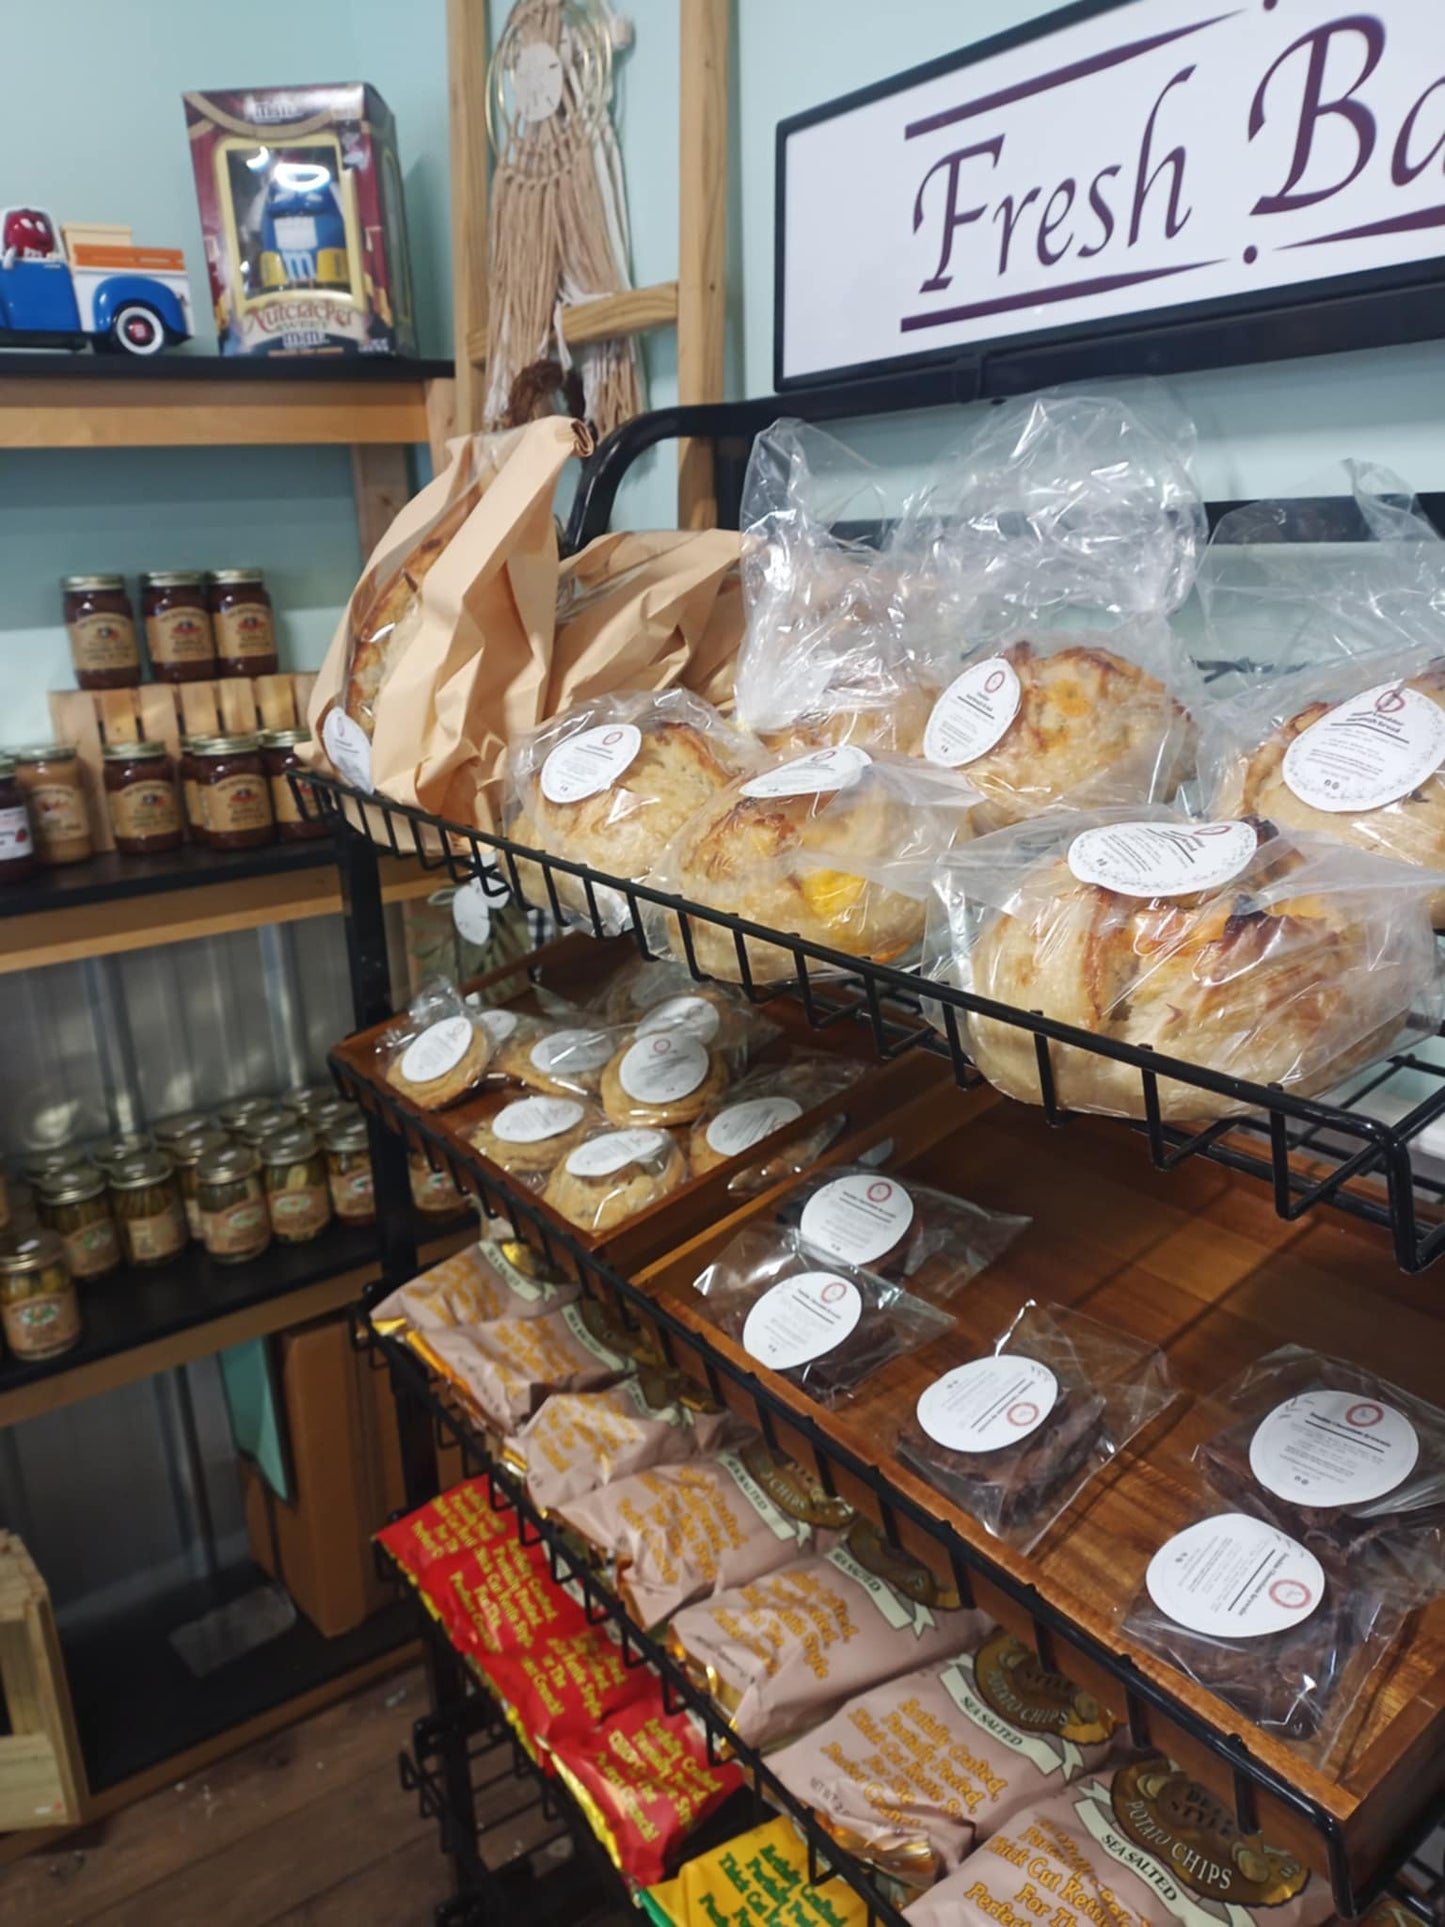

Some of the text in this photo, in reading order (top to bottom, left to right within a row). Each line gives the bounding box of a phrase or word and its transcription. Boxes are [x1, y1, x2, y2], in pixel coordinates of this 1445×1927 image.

[914, 64, 1197, 293] Fresh
[1027, 1856, 1063, 1892] Cut
[1102, 1832, 1126, 1857] SEA
[1125, 1852, 1178, 1902] SALTED
[1126, 1800, 1171, 1846] POTATO
[1170, 1841, 1233, 1890] CHIPS
[1013, 1881, 1051, 1918] For
